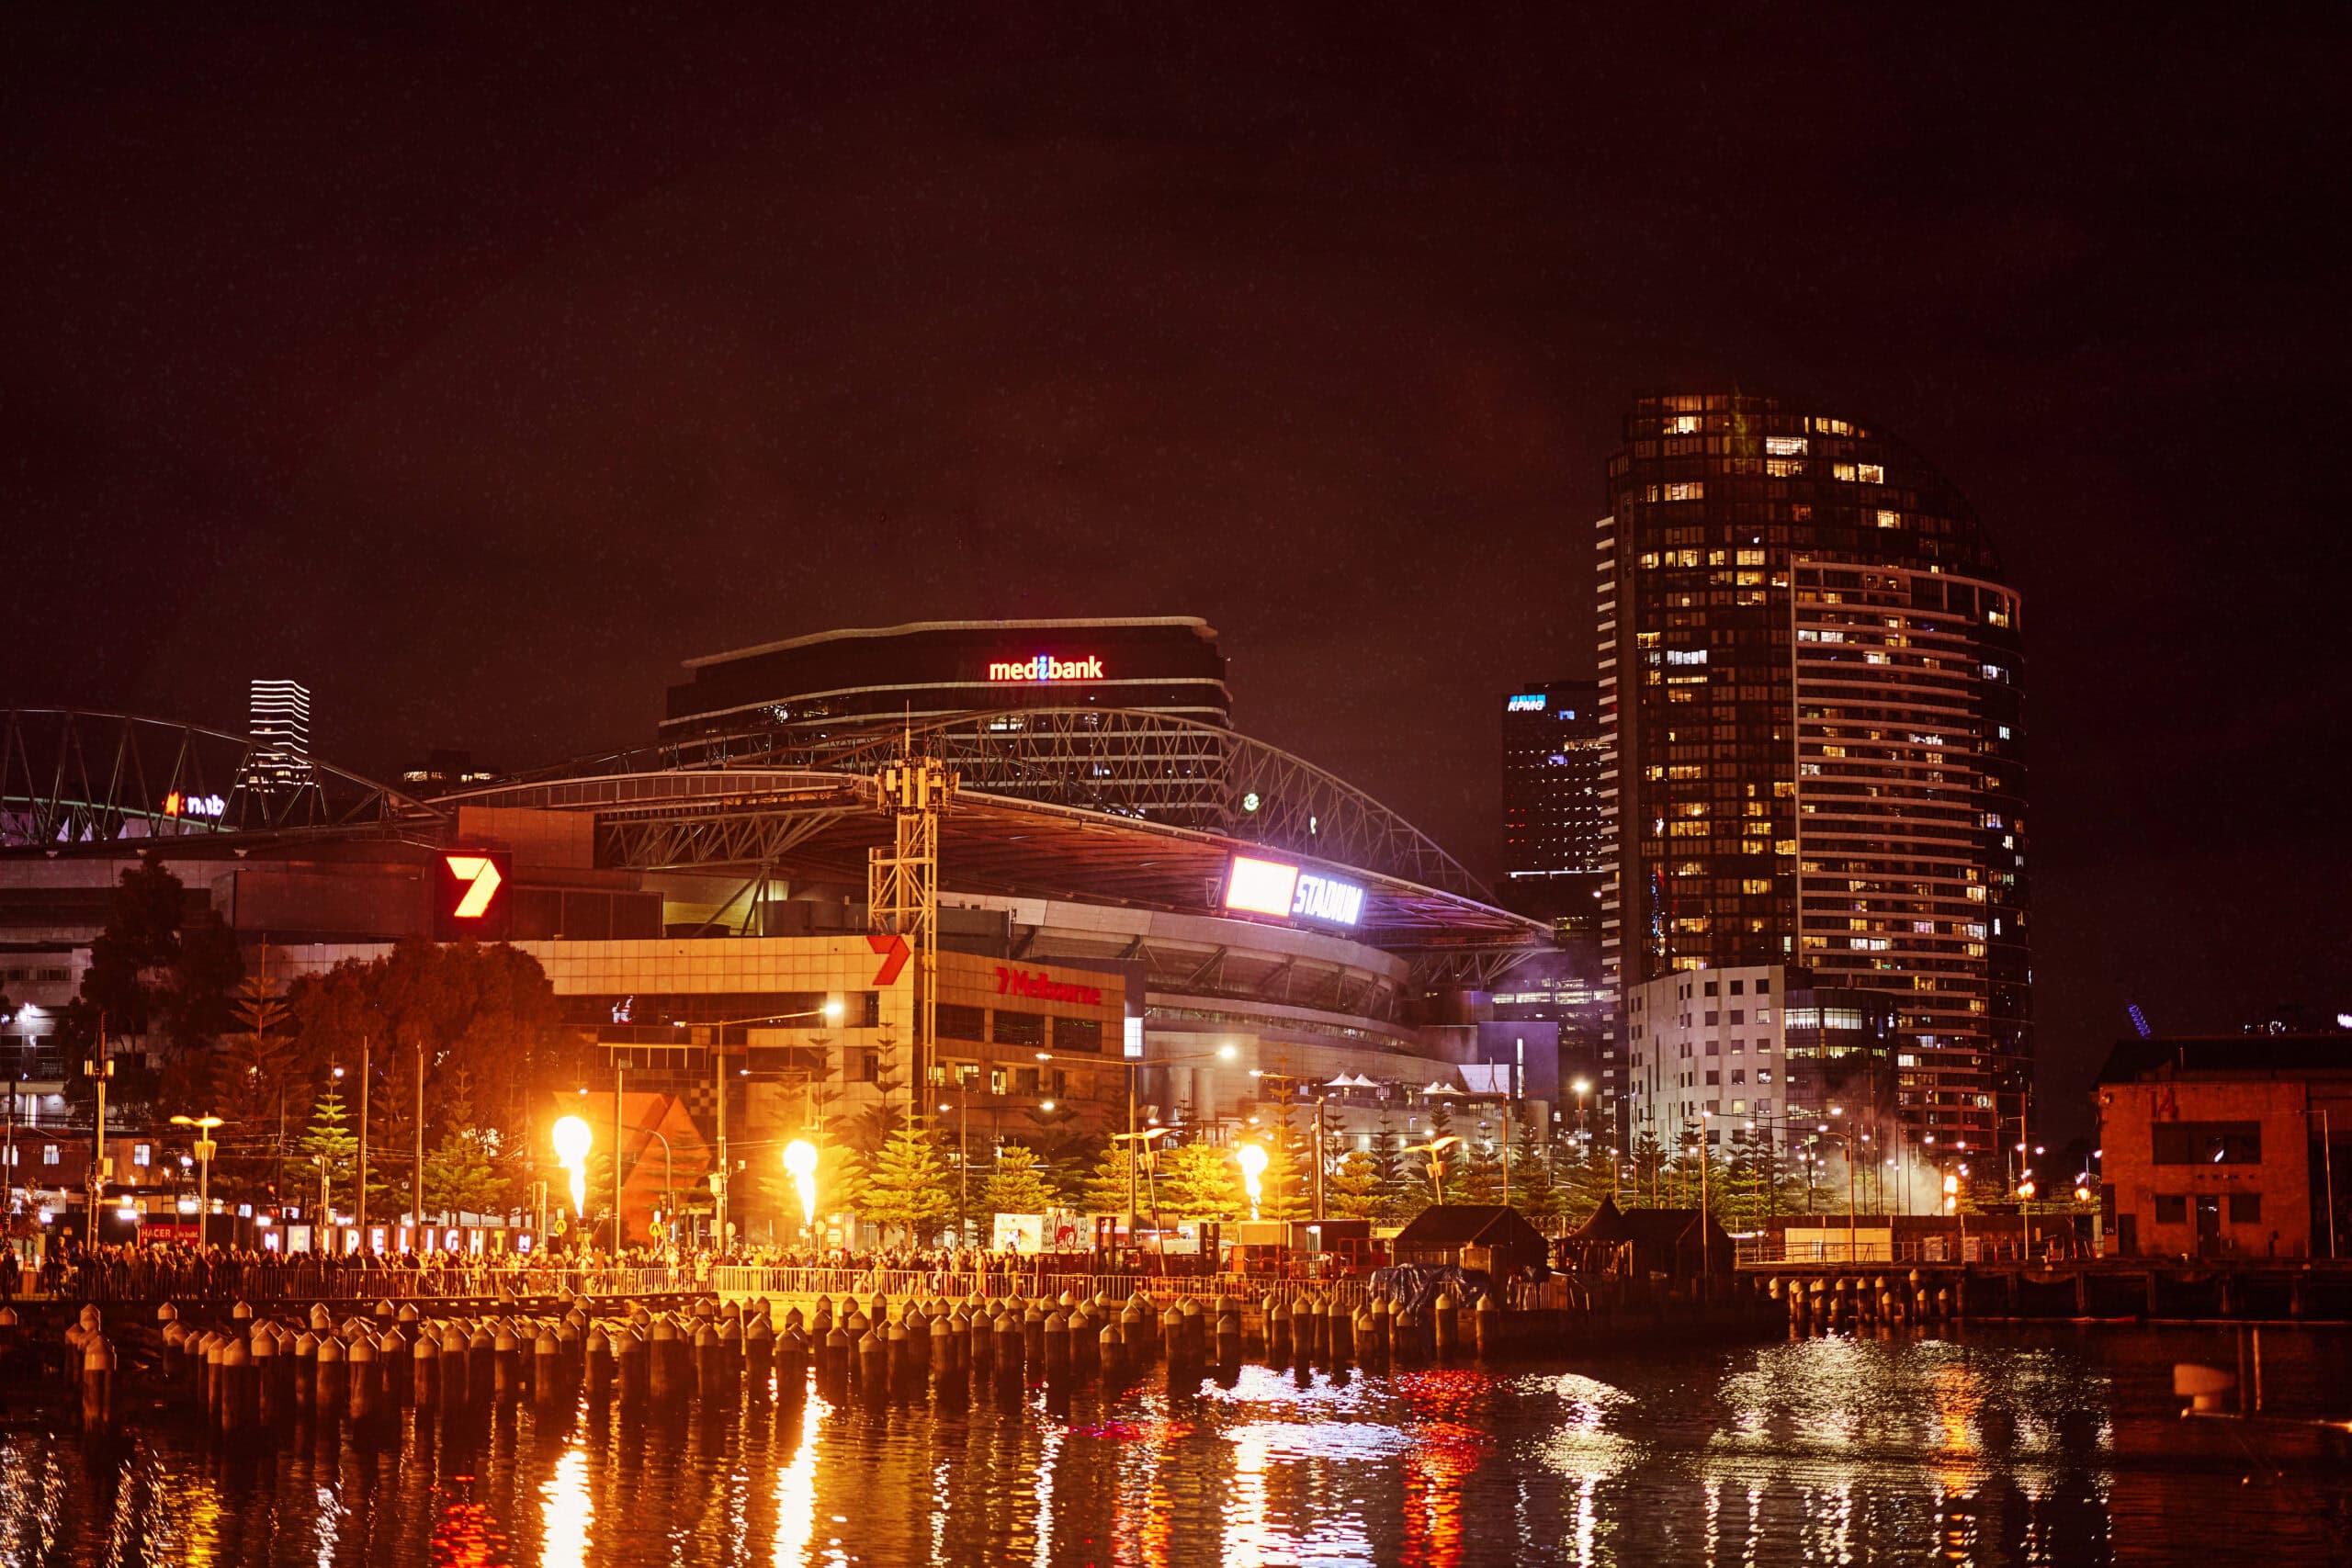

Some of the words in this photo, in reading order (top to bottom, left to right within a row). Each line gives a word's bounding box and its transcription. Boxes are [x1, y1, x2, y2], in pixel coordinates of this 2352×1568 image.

[989, 655, 1103, 680] medibank
[1508, 700, 1544, 712] KPMG
[187, 794, 225, 816] nab
[446, 856, 502, 917] 7
[1292, 874, 1363, 925] STADIUM
[866, 935, 910, 985] 7
[996, 966, 1010, 994] 7
[1012, 969, 1102, 1006] Melbourne
[2151, 1088, 2179, 1120] 14
[141, 1228, 171, 1238] HACER
